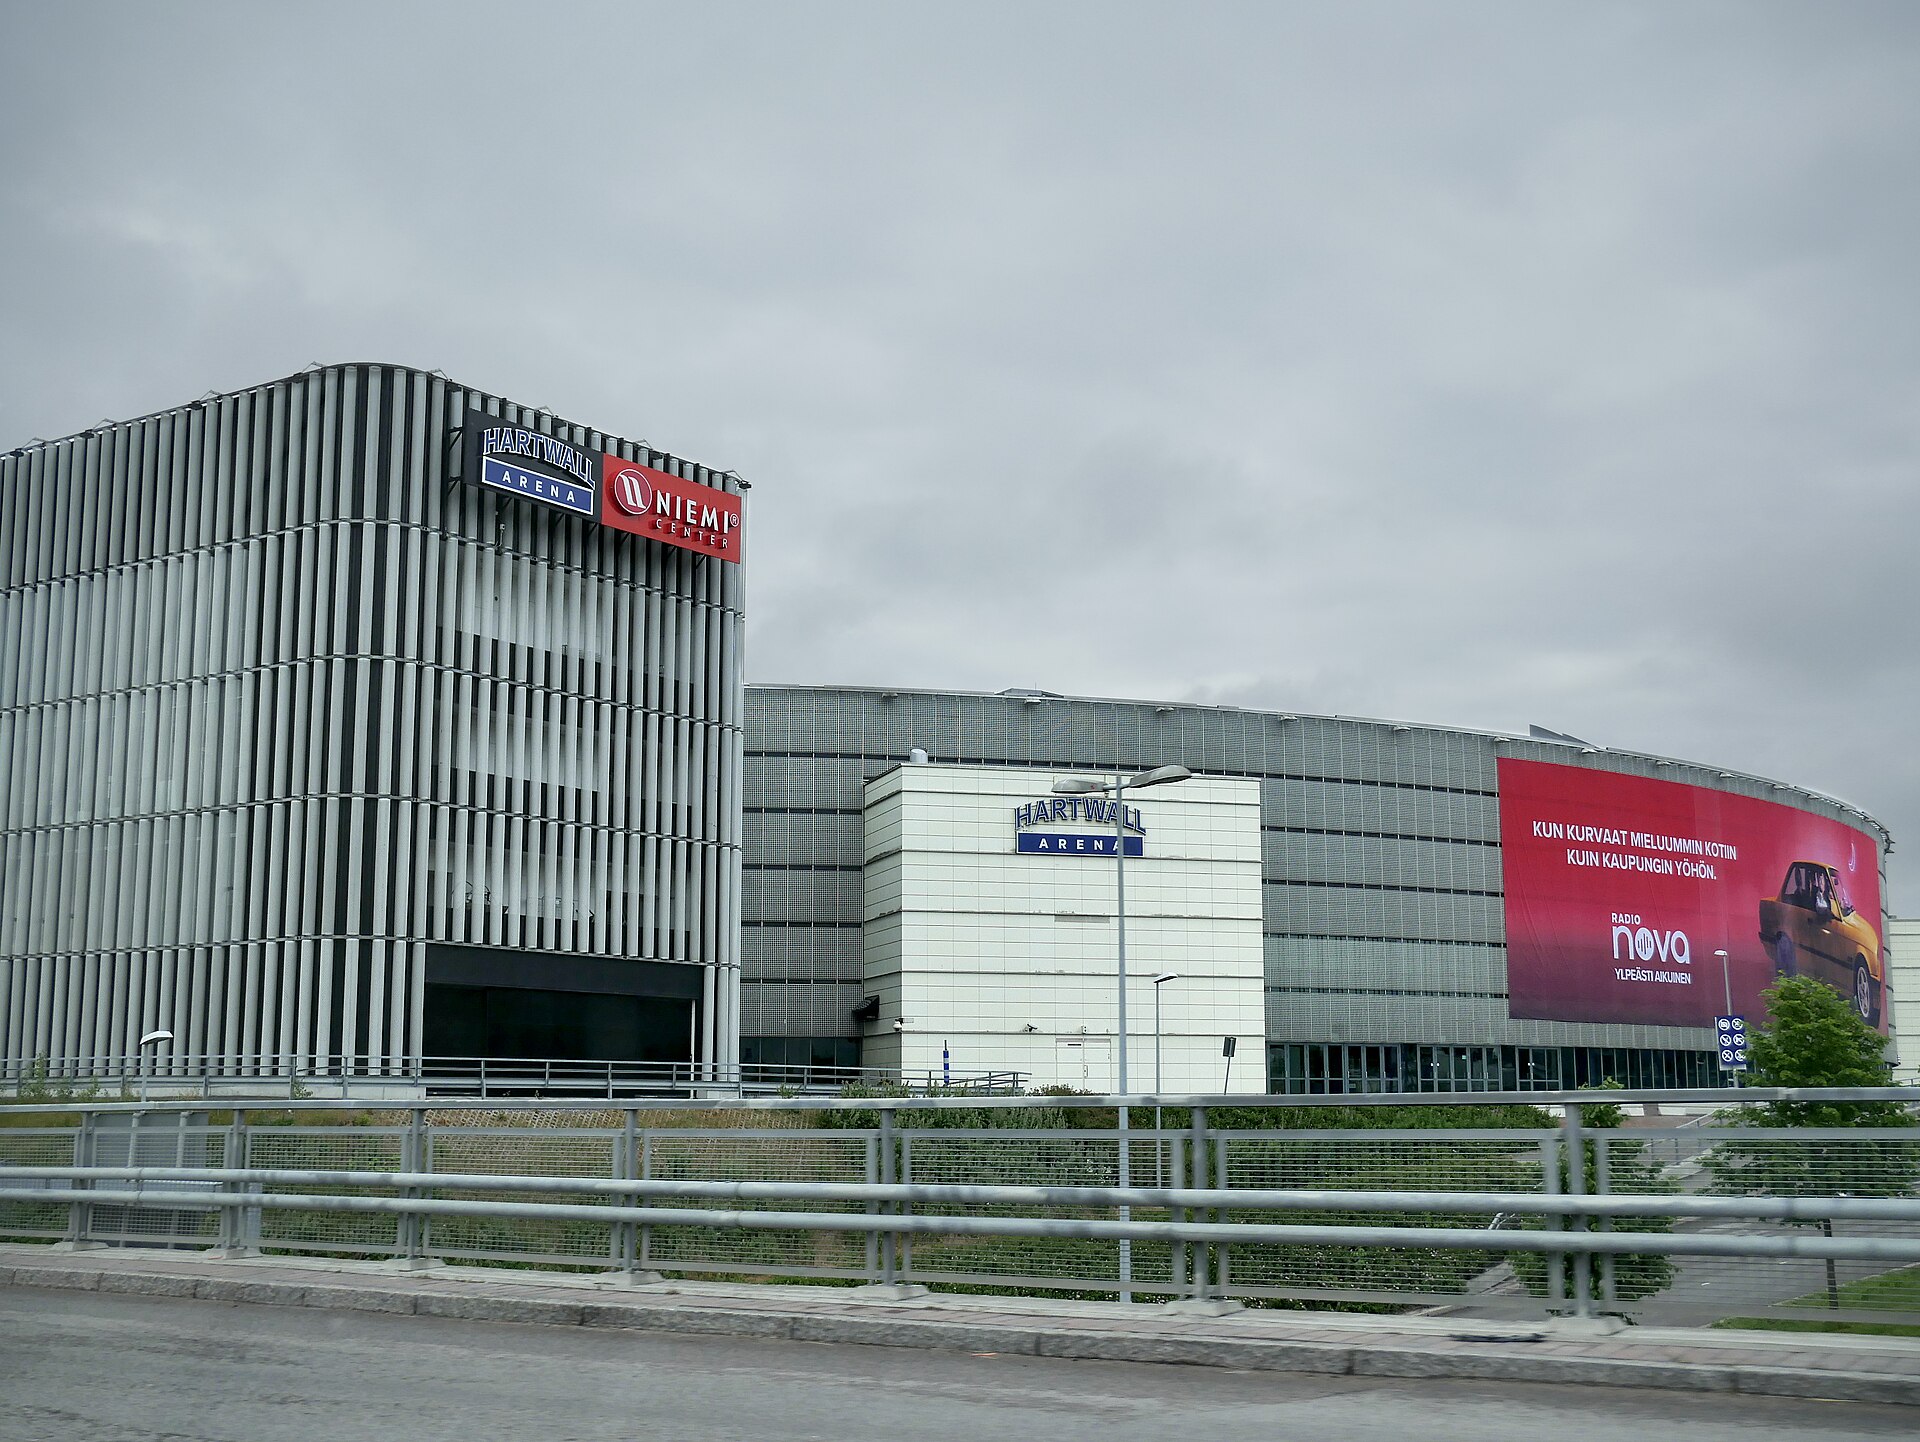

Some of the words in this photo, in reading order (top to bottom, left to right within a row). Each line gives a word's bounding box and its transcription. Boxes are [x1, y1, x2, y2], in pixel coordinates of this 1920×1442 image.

[482, 427, 595, 490] HARTWALL
[502, 470, 576, 503] ARENA
[656, 518, 728, 549] CENTER
[1014, 797, 1146, 836] HARTWALL
[1532, 820, 1564, 839] KUN
[1566, 824, 1627, 846] KURVAAT
[1630, 831, 1703, 855] MIELUUMMIN
[1705, 841, 1737, 861] KOTIIN
[1567, 849, 1599, 867] KUIN
[1602, 852, 1673, 875] KAUPUNGIN
[1674, 858, 1717, 880] YÖHÖN.
[1611, 912, 1641, 925] RADIO
[1612, 925, 1690, 964] nova
[1615, 966, 1654, 982] YLPEÄSTI
[1654, 970, 1692, 985] AIKUINEN
